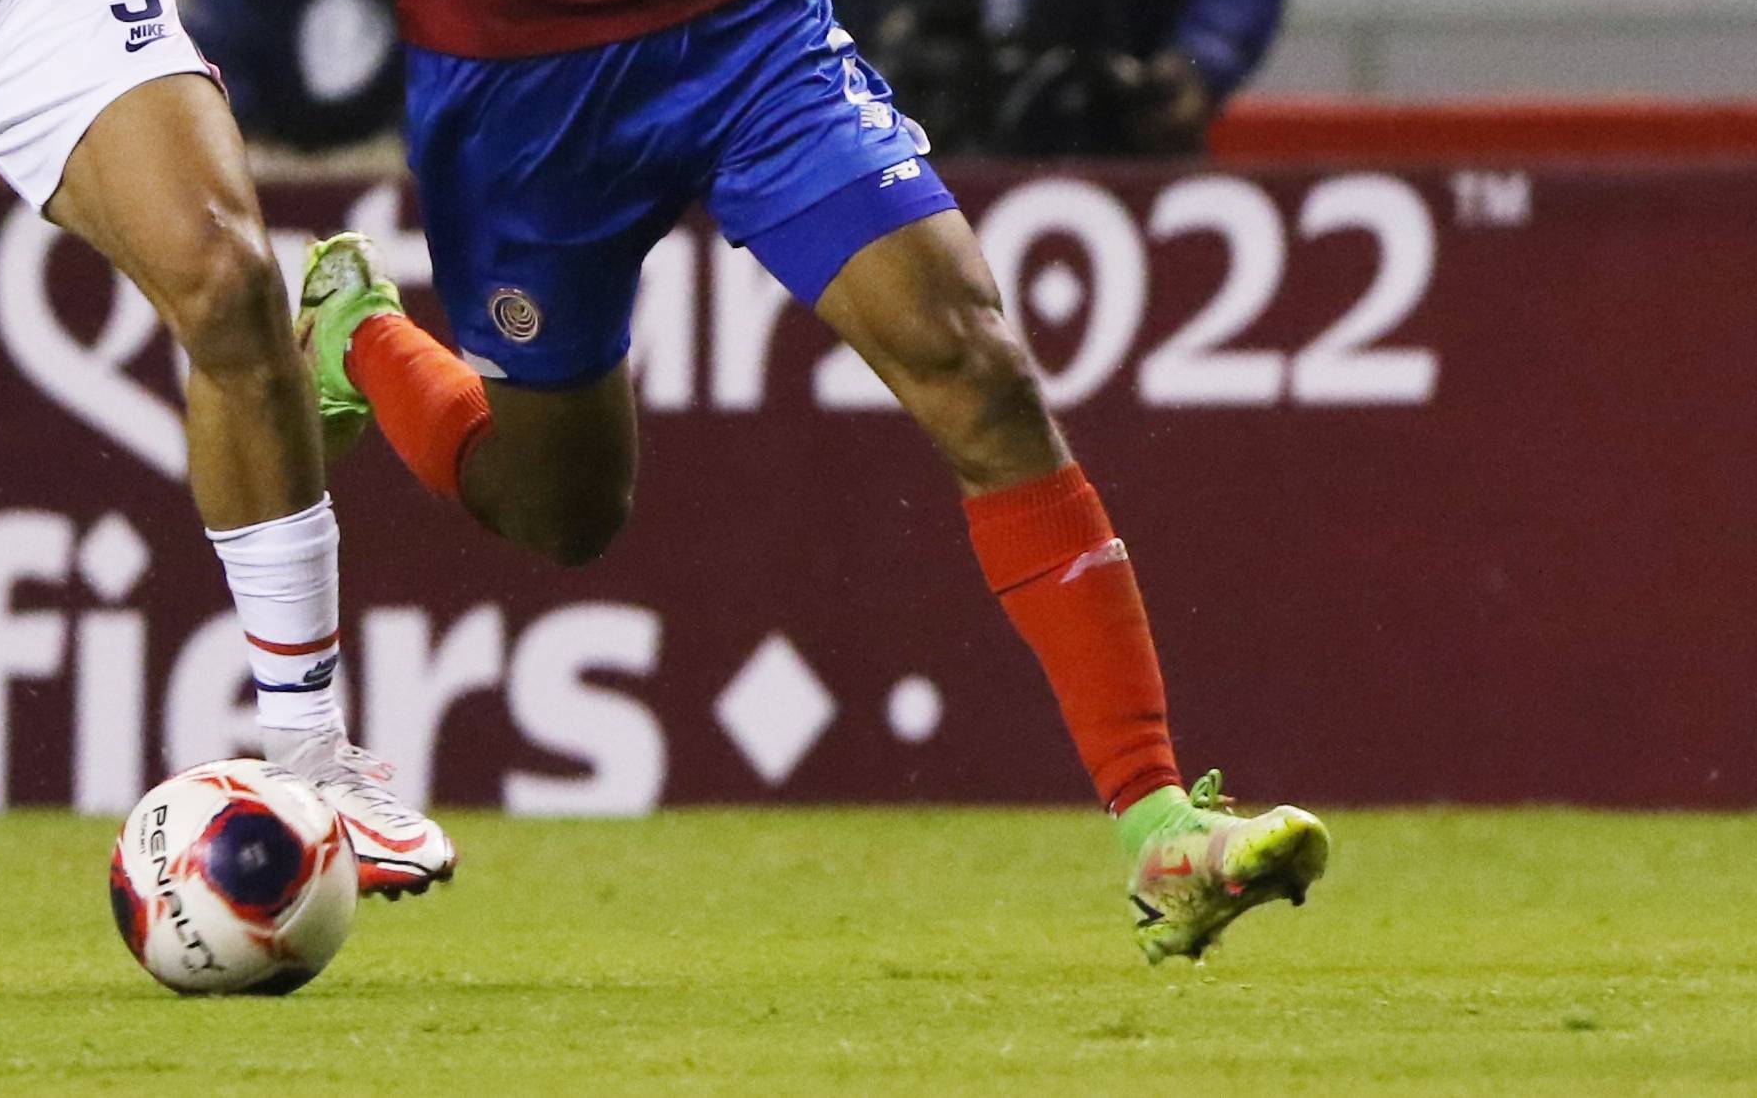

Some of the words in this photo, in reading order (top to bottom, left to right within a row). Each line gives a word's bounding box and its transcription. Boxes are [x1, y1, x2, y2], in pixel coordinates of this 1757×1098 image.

[129, 23, 166, 41] NIKE
[813, 171, 1439, 410] 022
[150, 803, 227, 973] PENALTY
